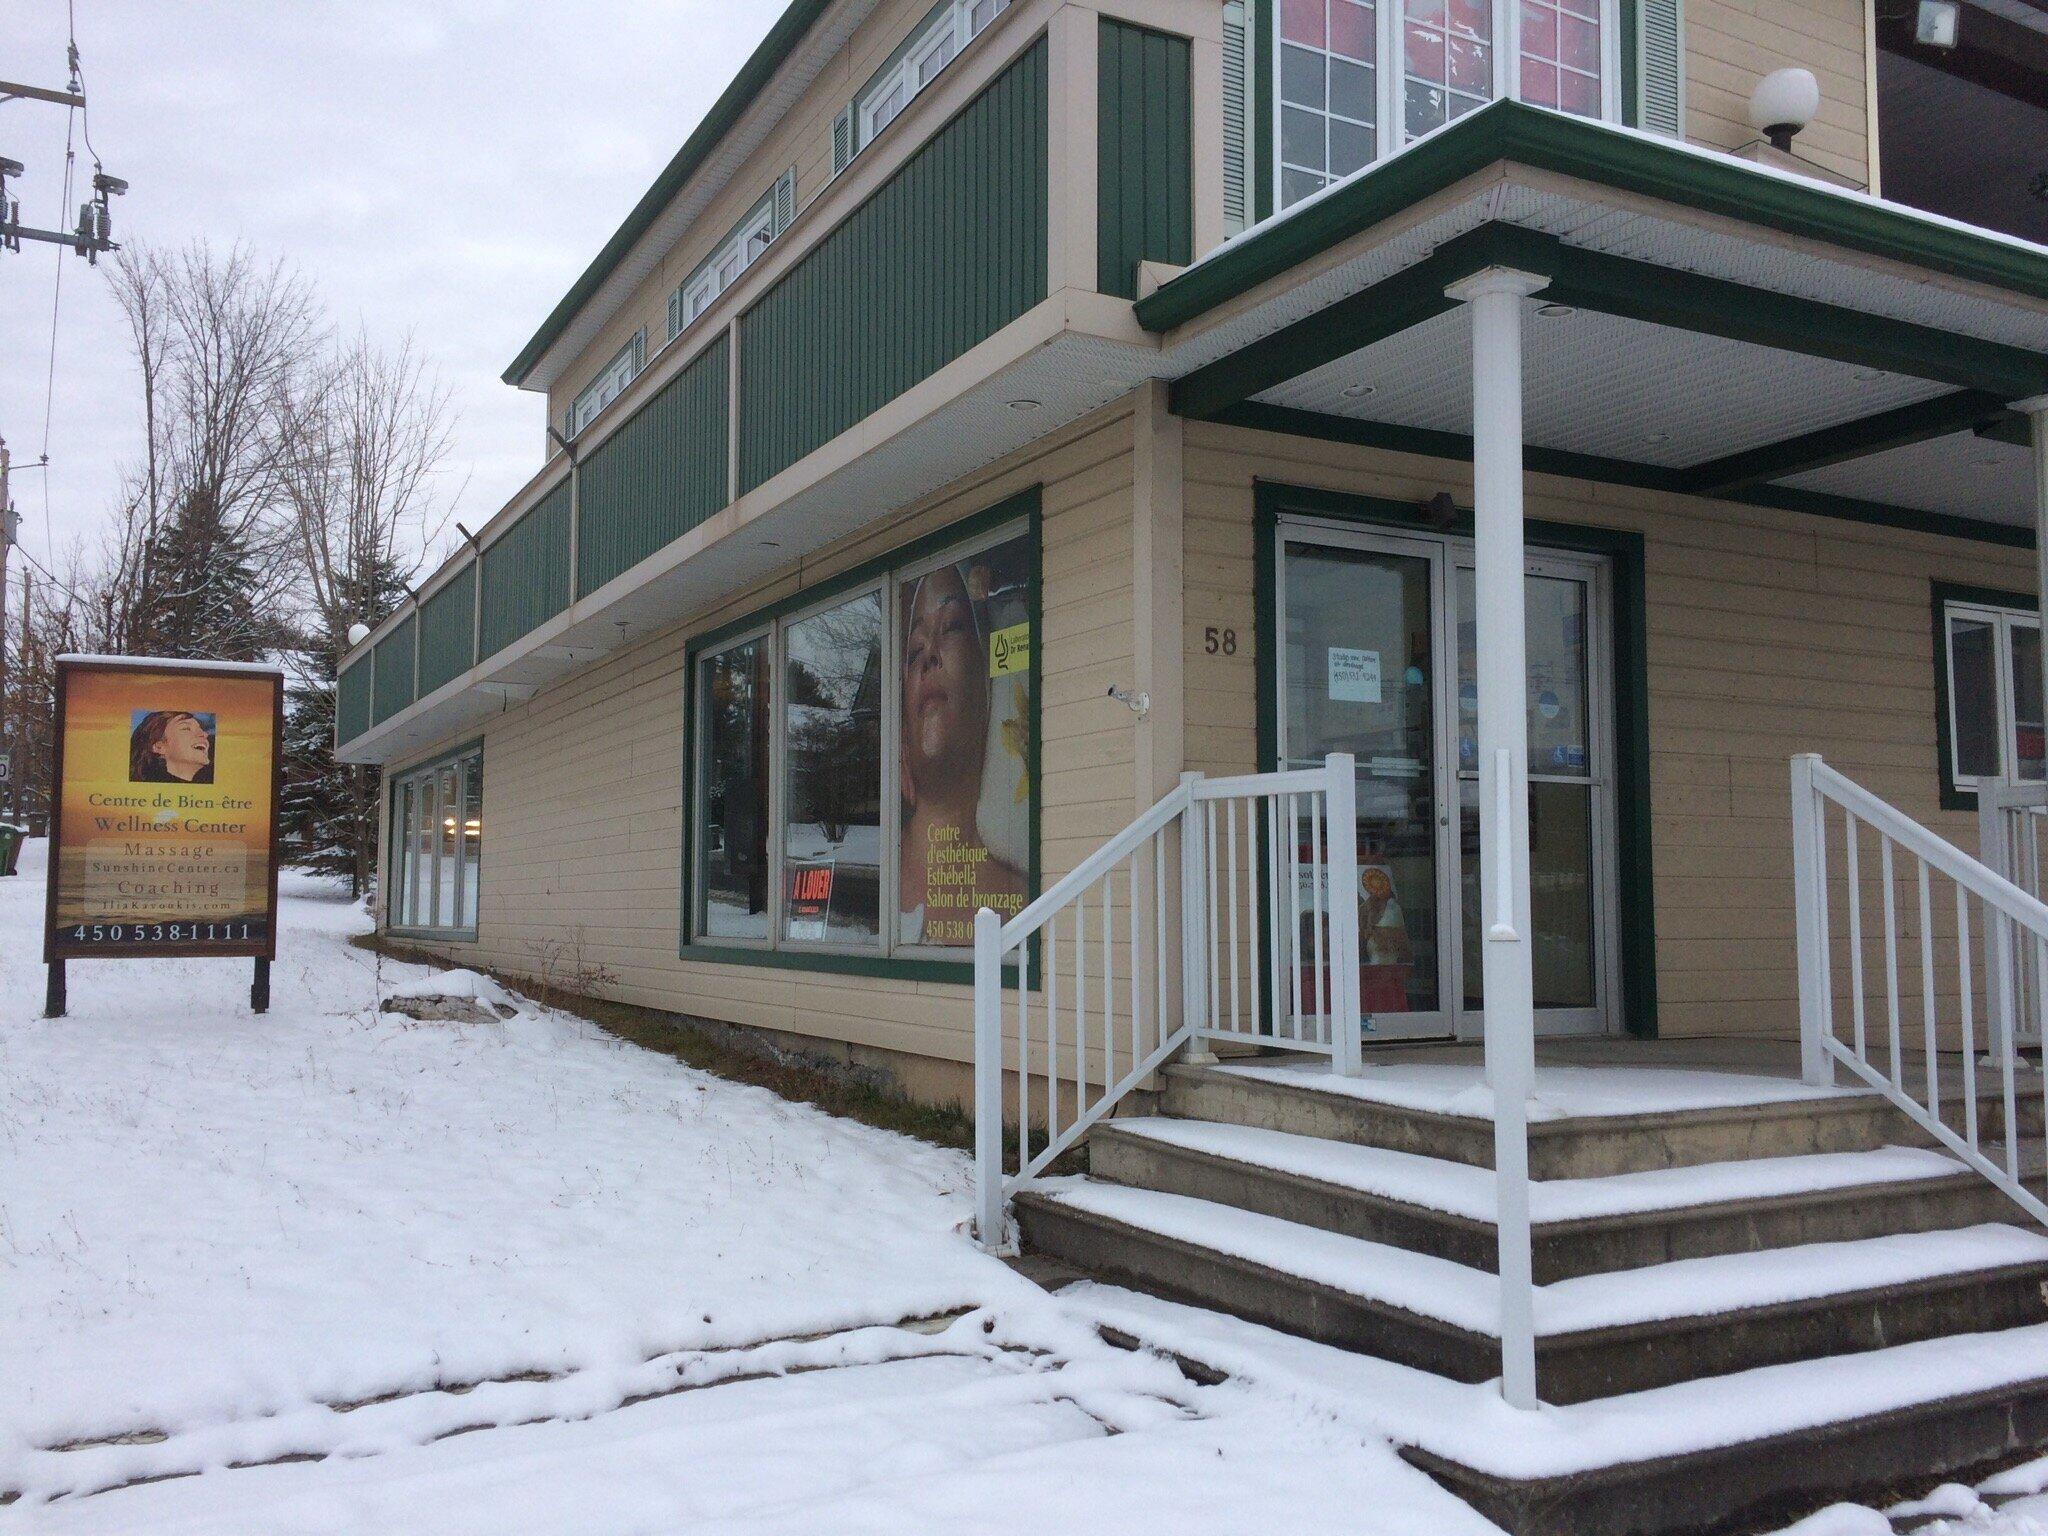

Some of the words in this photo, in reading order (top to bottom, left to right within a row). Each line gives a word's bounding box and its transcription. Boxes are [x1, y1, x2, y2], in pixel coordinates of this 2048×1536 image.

[1205, 627, 1237, 655] 58
[88, 793, 147, 807] Centre
[152, 793, 172, 808] de
[178, 795, 252, 809] Bien-être
[94, 816, 178, 832] Wellness
[184, 818, 246, 833] Center
[927, 823, 960, 841] Centre
[124, 843, 214, 860] Massage
[927, 842, 988, 869] d'esthétique
[92, 862, 239, 873] SunshineCenter.ca
[927, 864, 976, 886] Esthébella
[118, 881, 220, 897] Coaching
[801, 869, 830, 900] LOUER
[927, 887, 953, 907] Salon
[956, 887, 969, 908] de
[972, 887, 1023, 916] bronzage
[74, 925, 123, 941] 450
[134, 924, 249, 940] 538-1111
[926, 921, 944, 938] 450
[946, 921, 964, 939] 538
